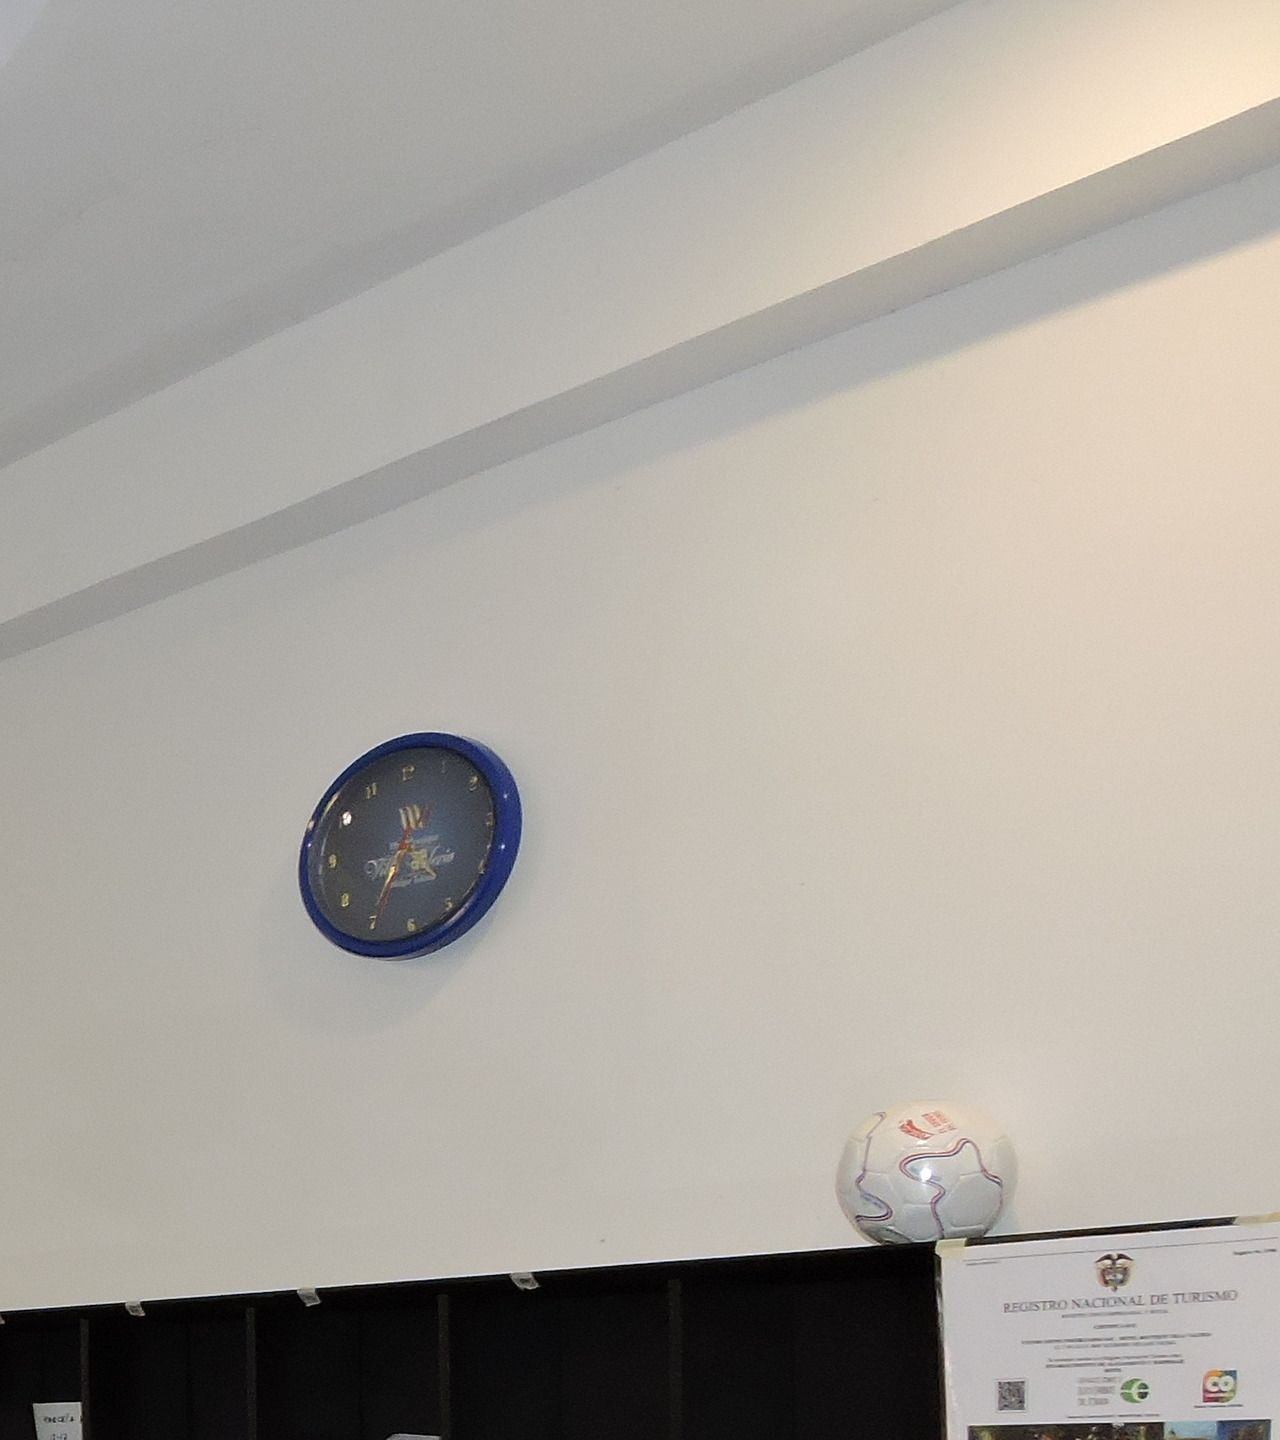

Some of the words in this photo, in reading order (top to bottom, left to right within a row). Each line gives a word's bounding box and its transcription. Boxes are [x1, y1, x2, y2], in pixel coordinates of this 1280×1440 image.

[328, 852, 338, 870] 9
[340, 892, 350, 908] 8
[444, 897, 453, 911] 5
[368, 914, 377, 930] 7
[406, 918, 417, 933] 6
[1003, 1299, 1067, 1313] REGISTRO
[1070, 1295, 1145, 1309] NACIONAL
[1149, 1293, 1169, 1306] DE
[1172, 1289, 1239, 1304] TURISMO
